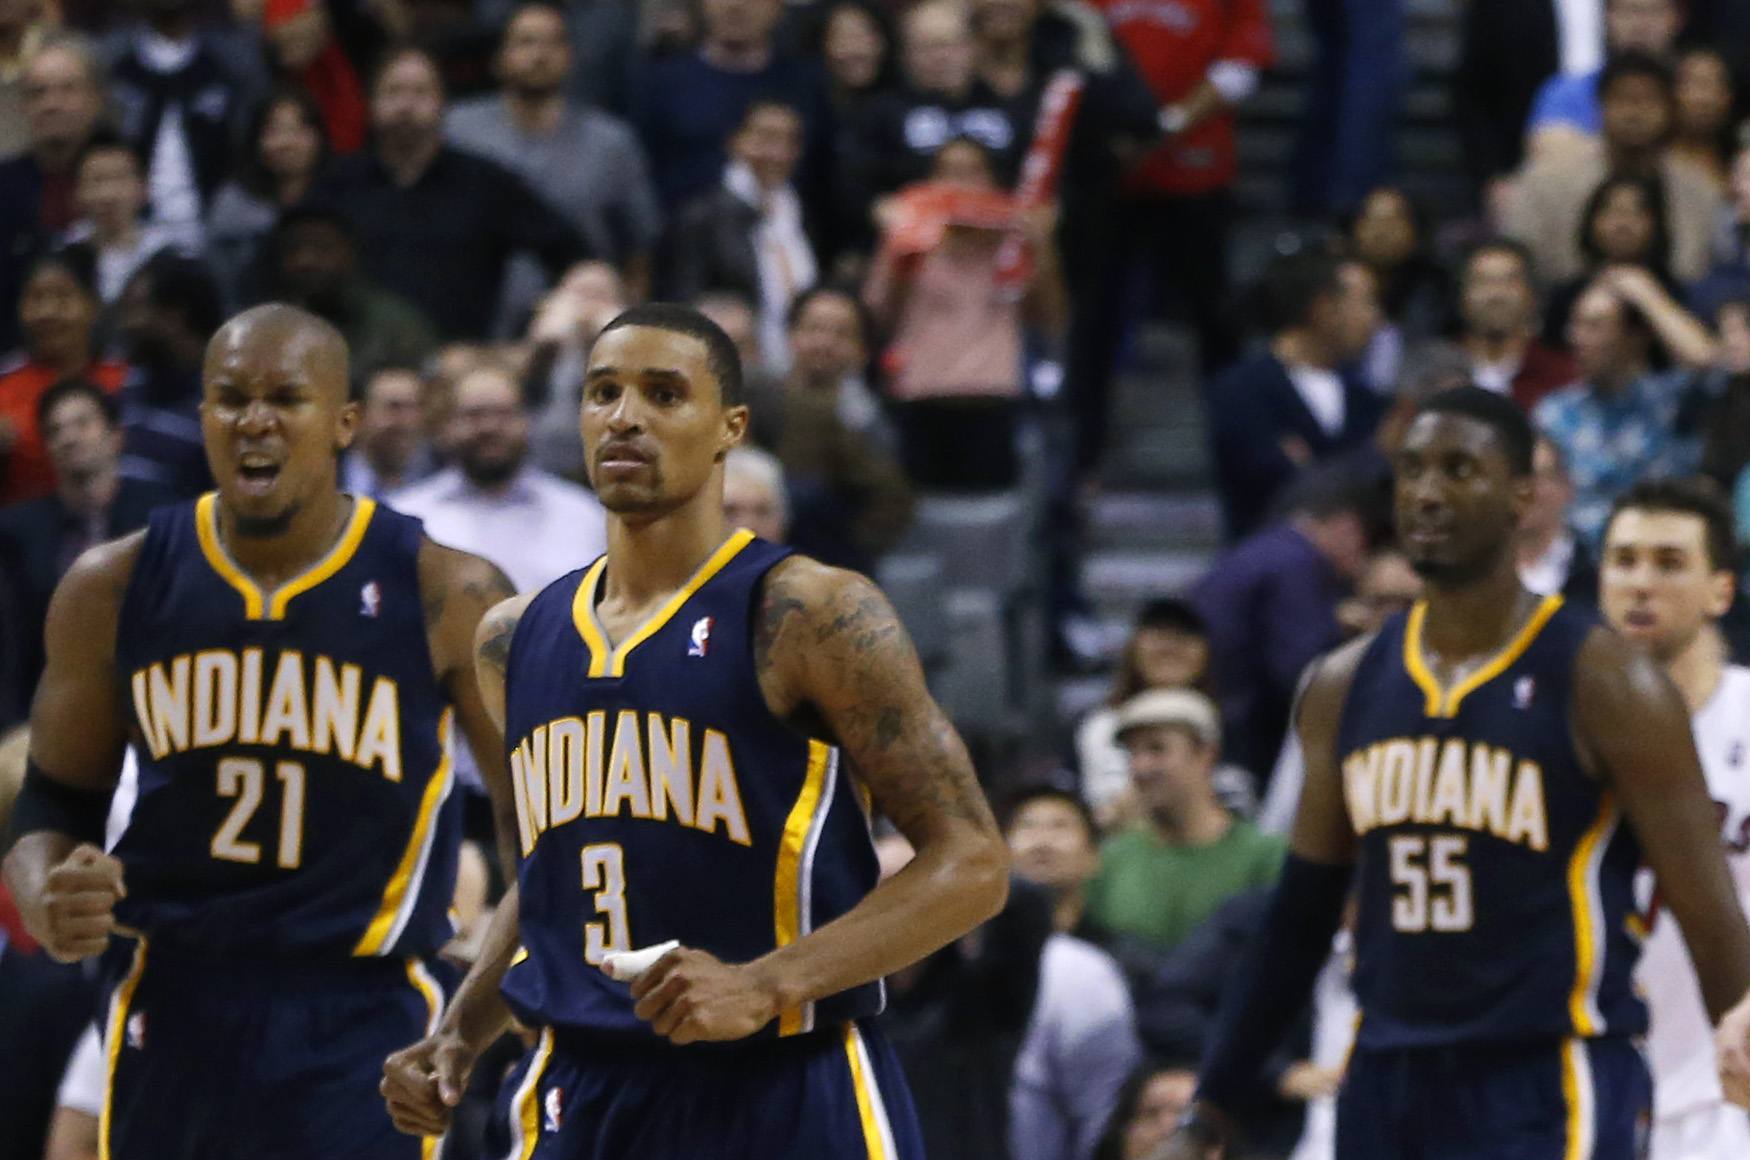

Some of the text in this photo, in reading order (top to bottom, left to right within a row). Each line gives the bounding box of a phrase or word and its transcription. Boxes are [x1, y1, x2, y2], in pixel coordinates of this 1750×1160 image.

[131, 646, 403, 782] INDIANA
[210, 756, 305, 869] 21
[510, 709, 752, 858] INDIANA
[1342, 736, 1548, 852] INDIANA
[581, 841, 633, 966] 3
[1389, 835, 1473, 933] 55
